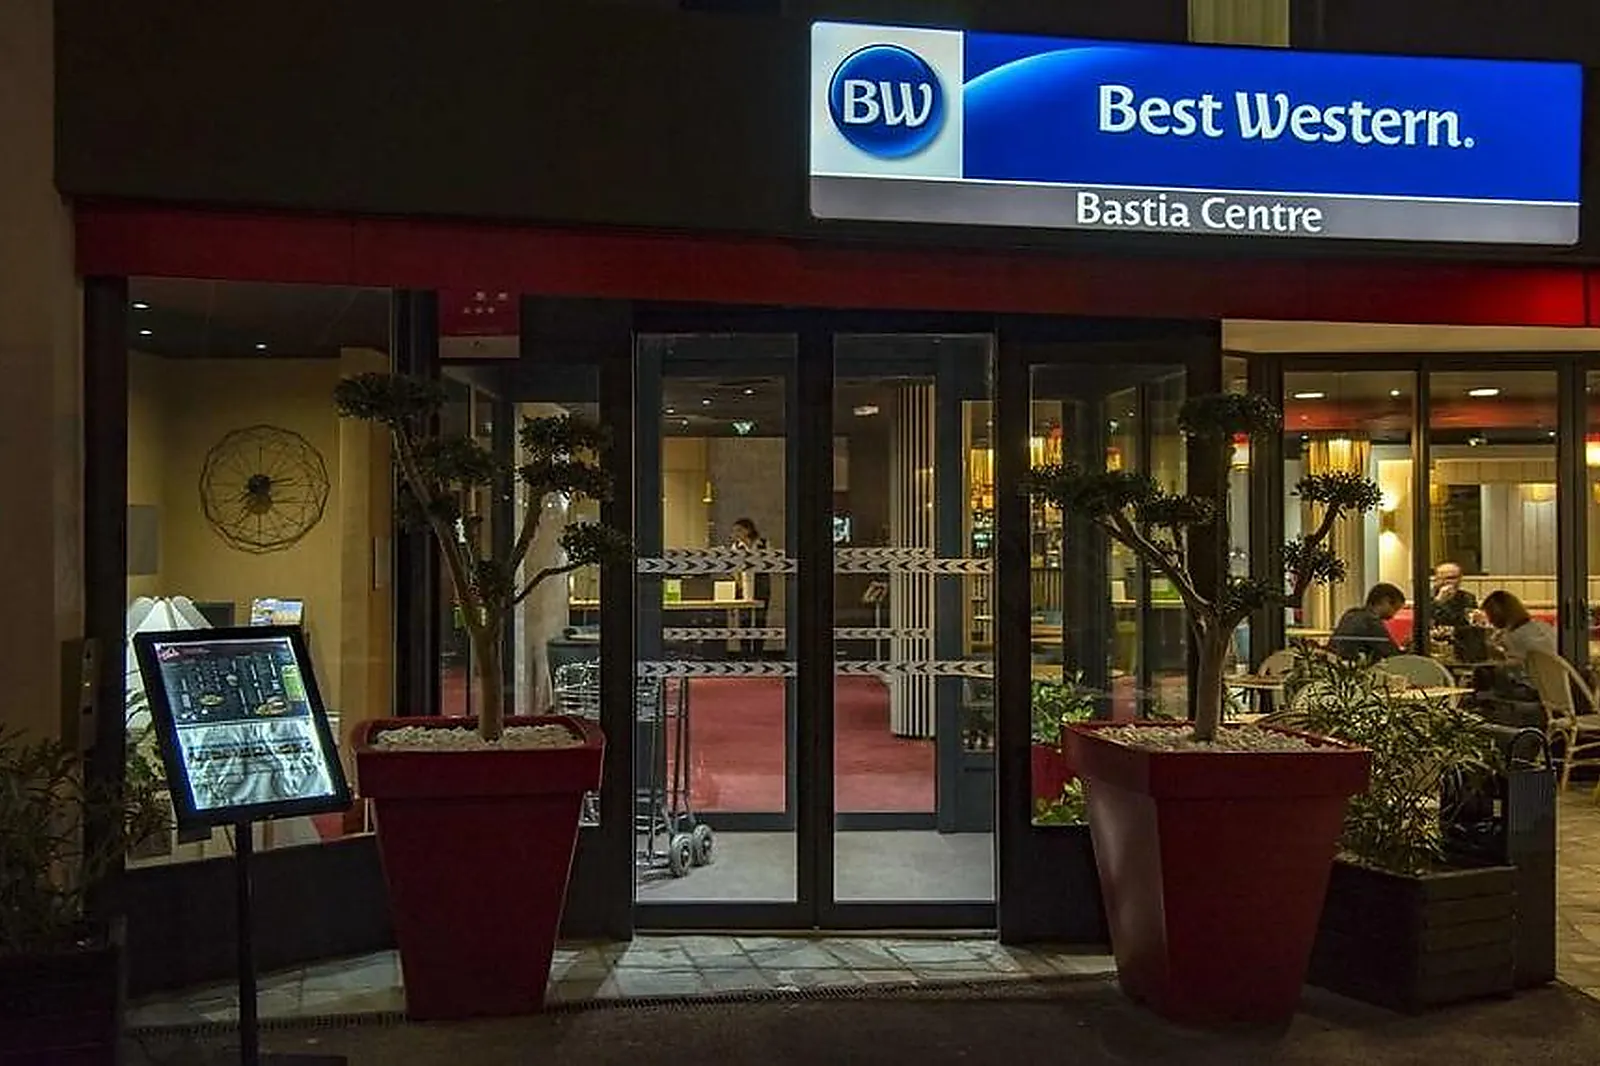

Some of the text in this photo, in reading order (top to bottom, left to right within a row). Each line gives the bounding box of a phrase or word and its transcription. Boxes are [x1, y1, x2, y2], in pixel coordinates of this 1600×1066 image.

[844, 79, 932, 127] BW
[1099, 85, 1224, 137] Best
[1077, 191, 1323, 233] Bastia Centre
